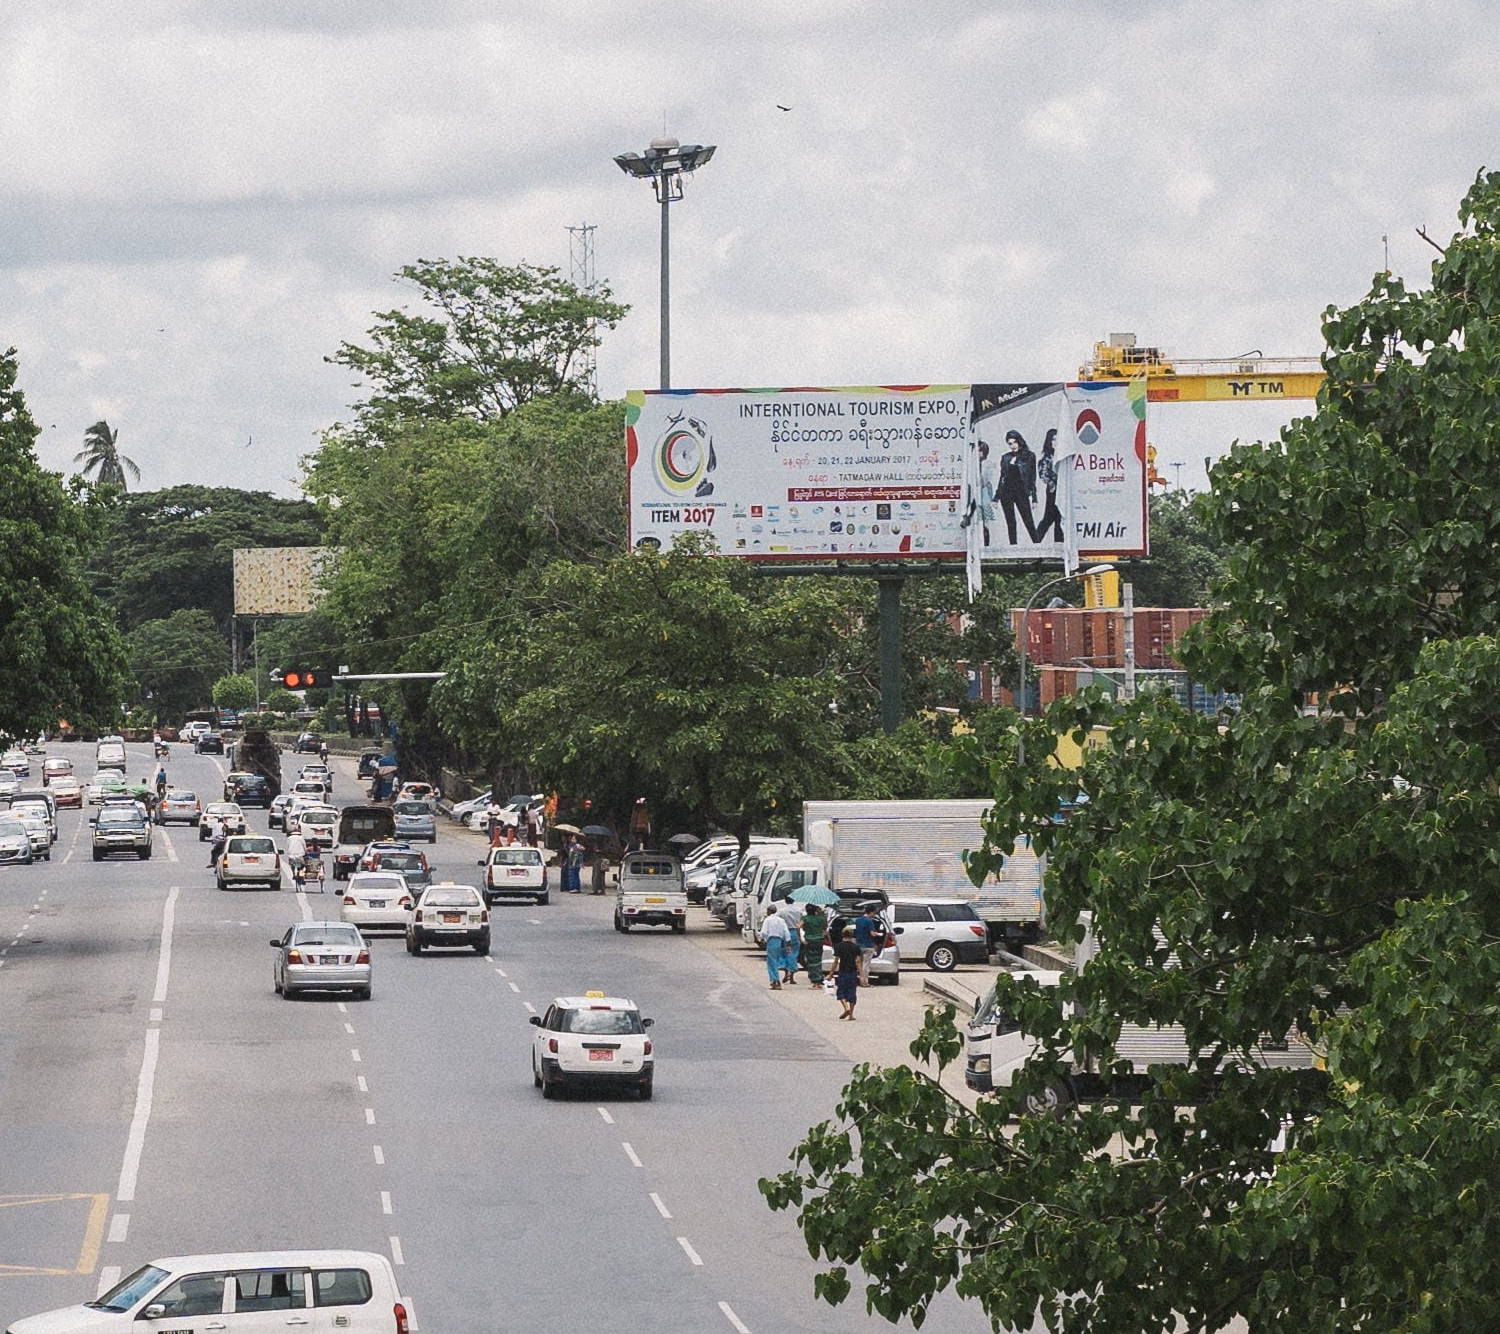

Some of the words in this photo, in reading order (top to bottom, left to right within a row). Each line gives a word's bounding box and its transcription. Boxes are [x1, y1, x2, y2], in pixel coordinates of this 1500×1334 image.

[1257, 382, 1284, 393] TM
[739, 403, 845, 417] INTERNTIONAL
[850, 402, 914, 416] TOURISM
[918, 401, 960, 416] EXPO,
[855, 455, 891, 464] JANUARY
[893, 455, 911, 464] 2017
[1090, 453, 1124, 470] Bank
[883, 472, 903, 480] HALL
[651, 510, 680, 523] ITEM
[683, 508, 715, 526] 2017
[1104, 521, 1127, 538] Air
